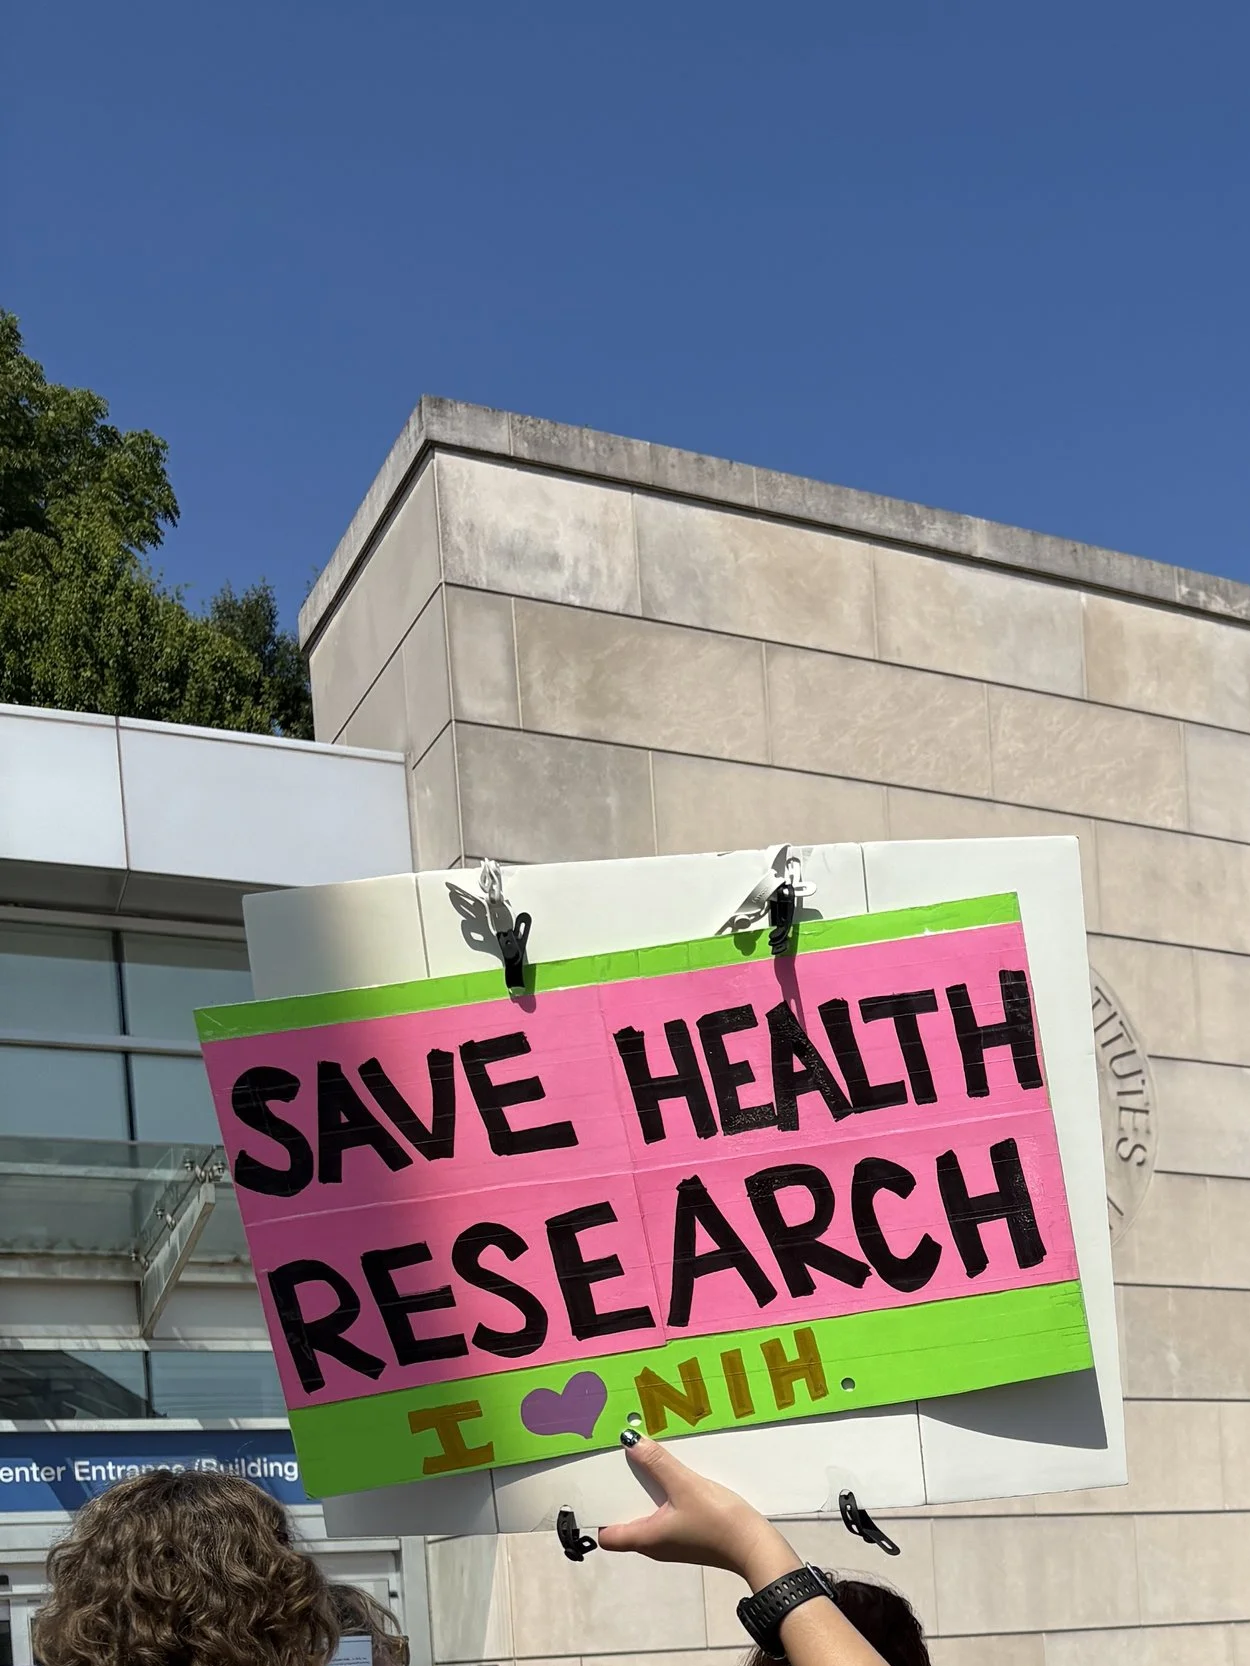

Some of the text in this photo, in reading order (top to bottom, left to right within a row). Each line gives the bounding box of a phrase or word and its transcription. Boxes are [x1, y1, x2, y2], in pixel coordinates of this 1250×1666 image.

[231, 969, 1044, 1197] SAVE HEALTH
[267, 1138, 1046, 1396] RESEARCH
[408, 1327, 829, 1475] I NIH
